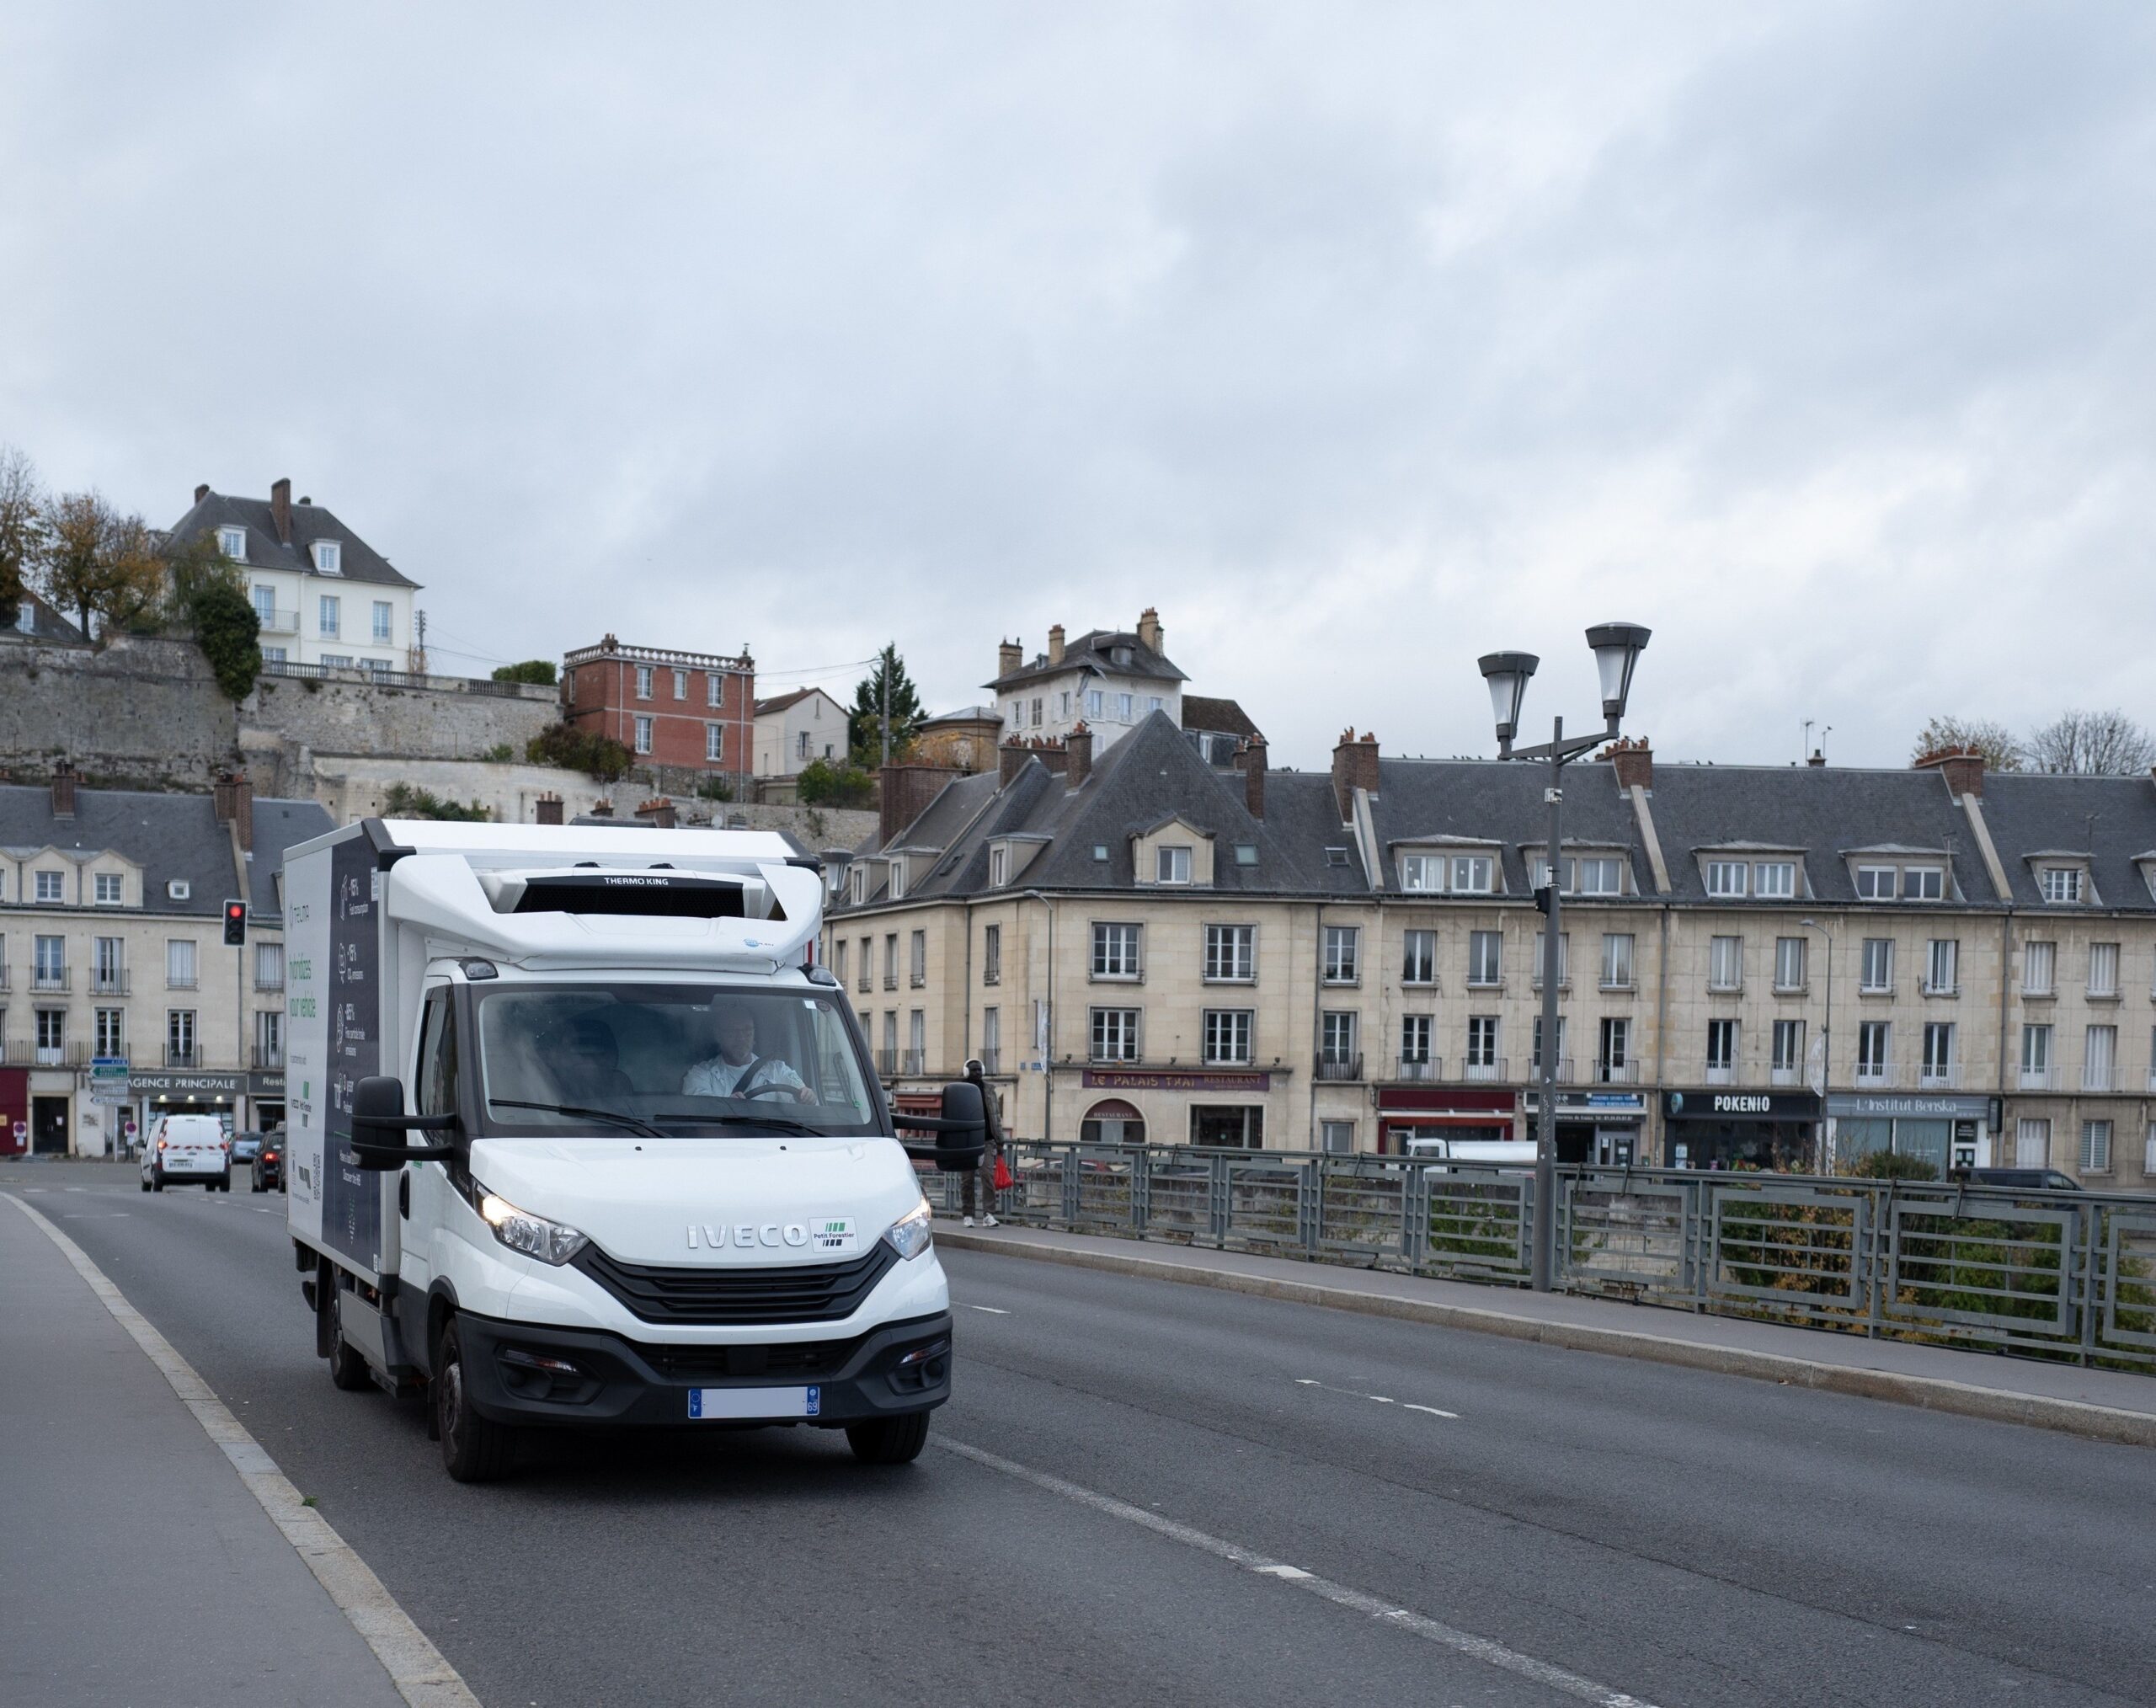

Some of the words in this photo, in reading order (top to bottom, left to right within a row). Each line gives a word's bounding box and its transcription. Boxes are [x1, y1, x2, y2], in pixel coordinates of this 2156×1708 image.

[127, 1077, 170, 1089] AGENCE
[175, 1078, 236, 1089] PRINCIPALE
[1091, 1076, 1106, 1086] LE
[1114, 1076, 1159, 1086] PALAIS
[1166, 1076, 1195, 1087] THAI
[1203, 1076, 1261, 1085] RESTAURANT
[1714, 1096, 1770, 1112] POKENIO
[686, 1224, 808, 1250] IVECO
[808, 1401, 818, 1412] 69
